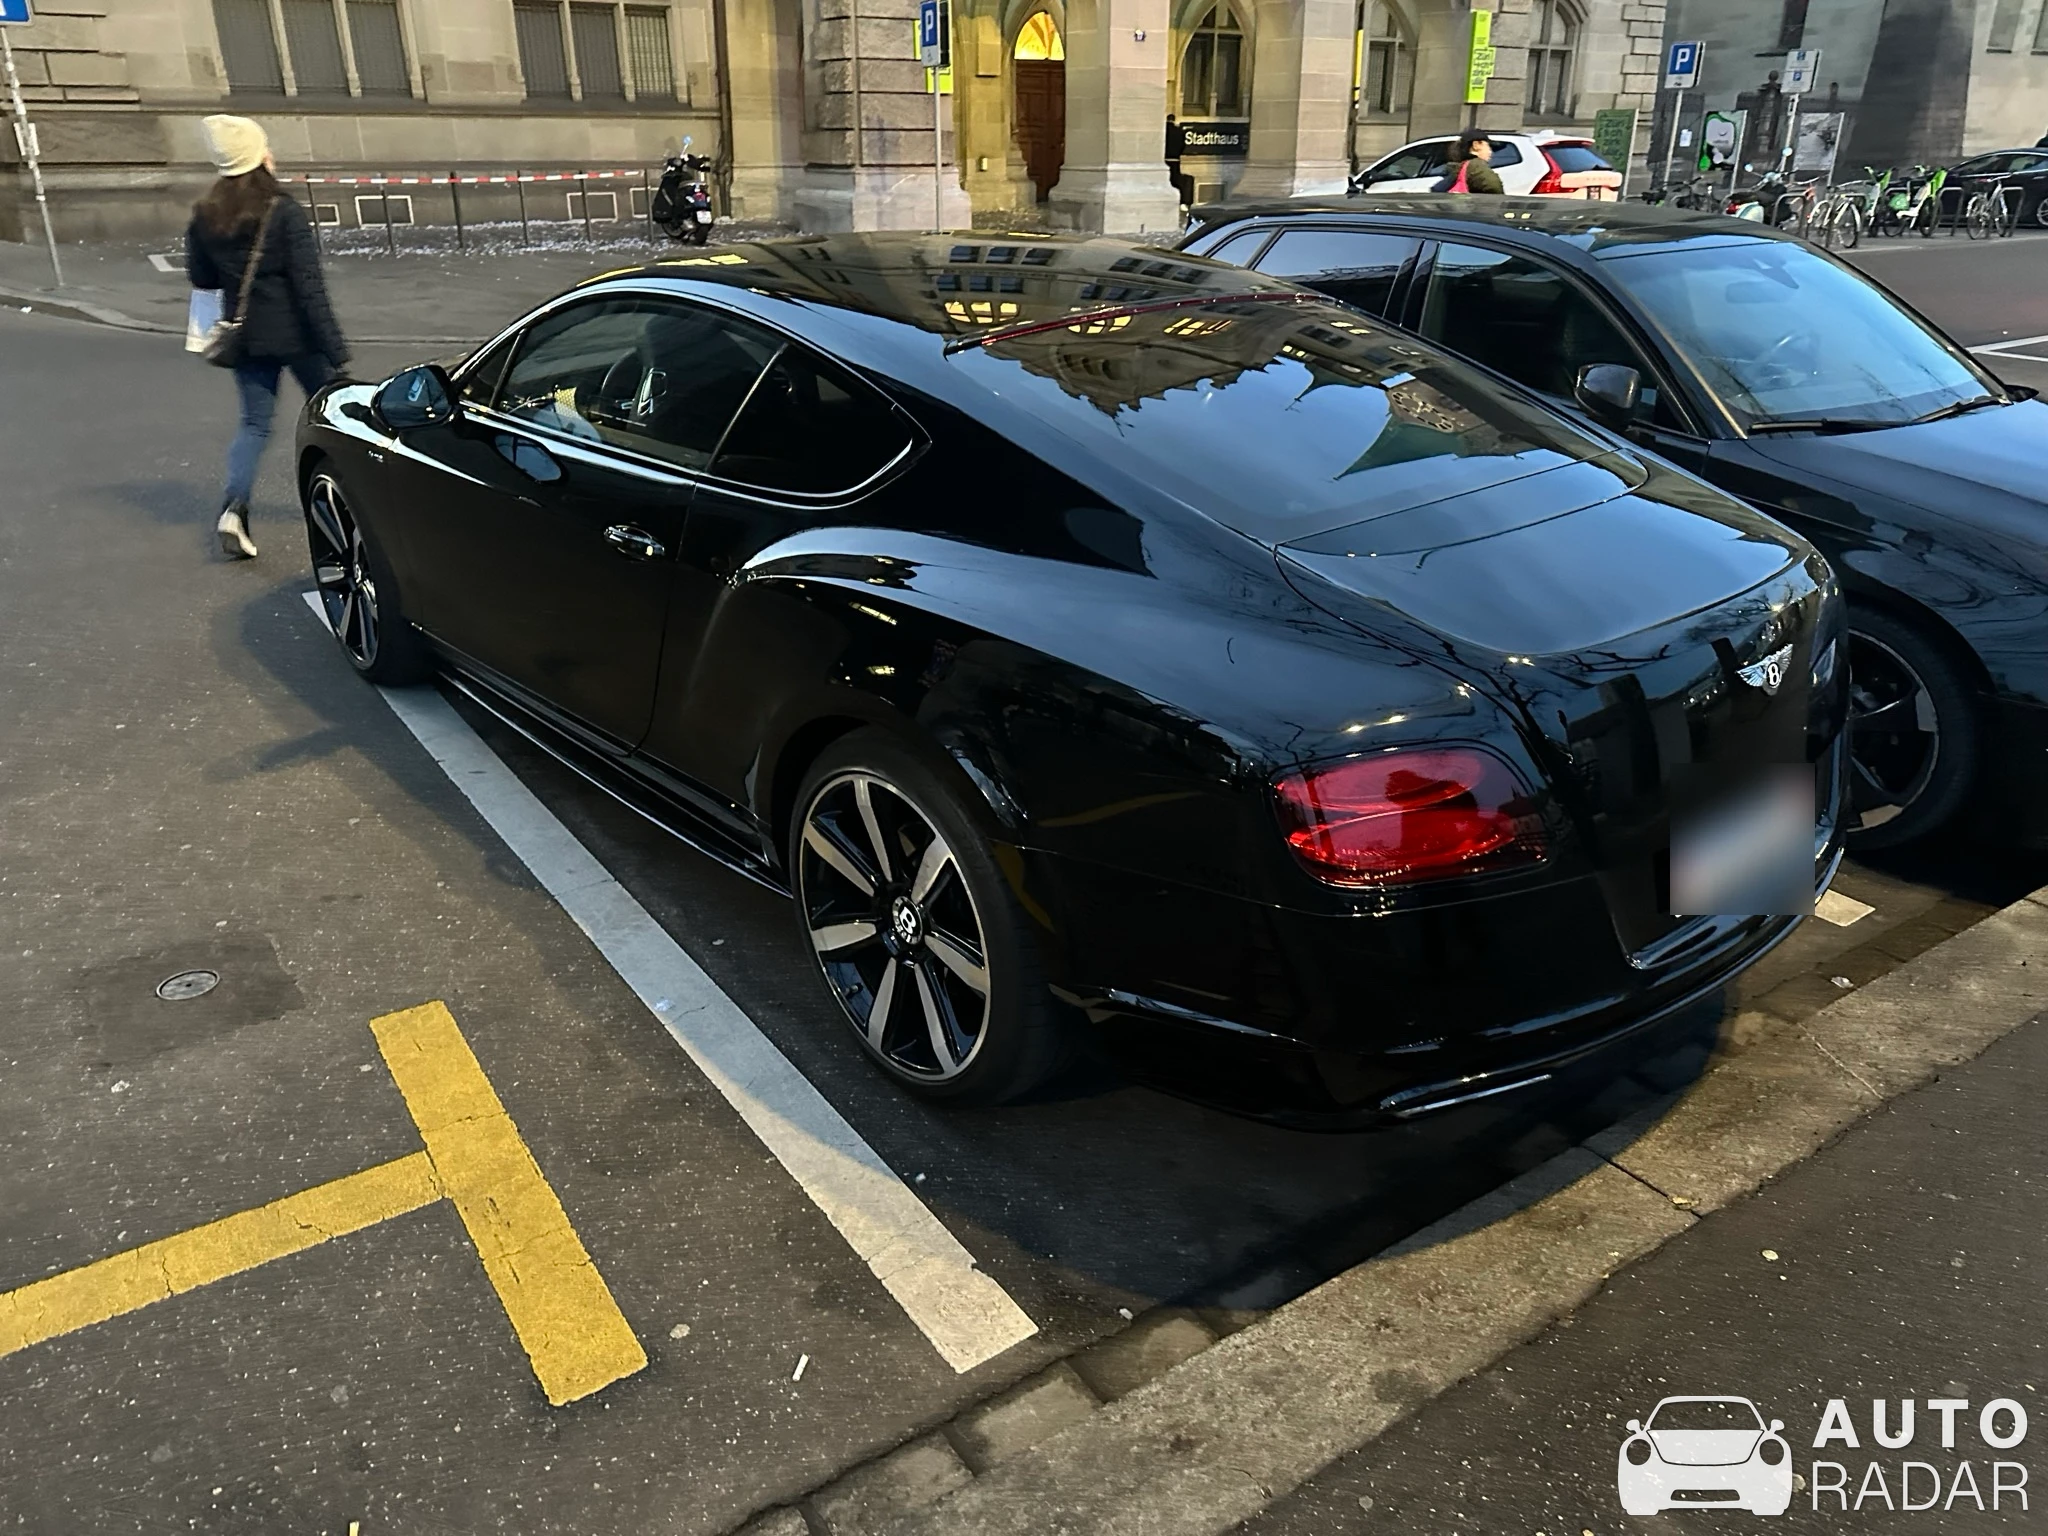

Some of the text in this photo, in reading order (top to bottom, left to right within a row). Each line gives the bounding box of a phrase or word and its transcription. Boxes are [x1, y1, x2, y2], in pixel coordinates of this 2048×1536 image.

[924, 9, 934, 42] P
[1675, 48, 1690, 71] P
[1184, 131, 1239, 145] Stadthaus
